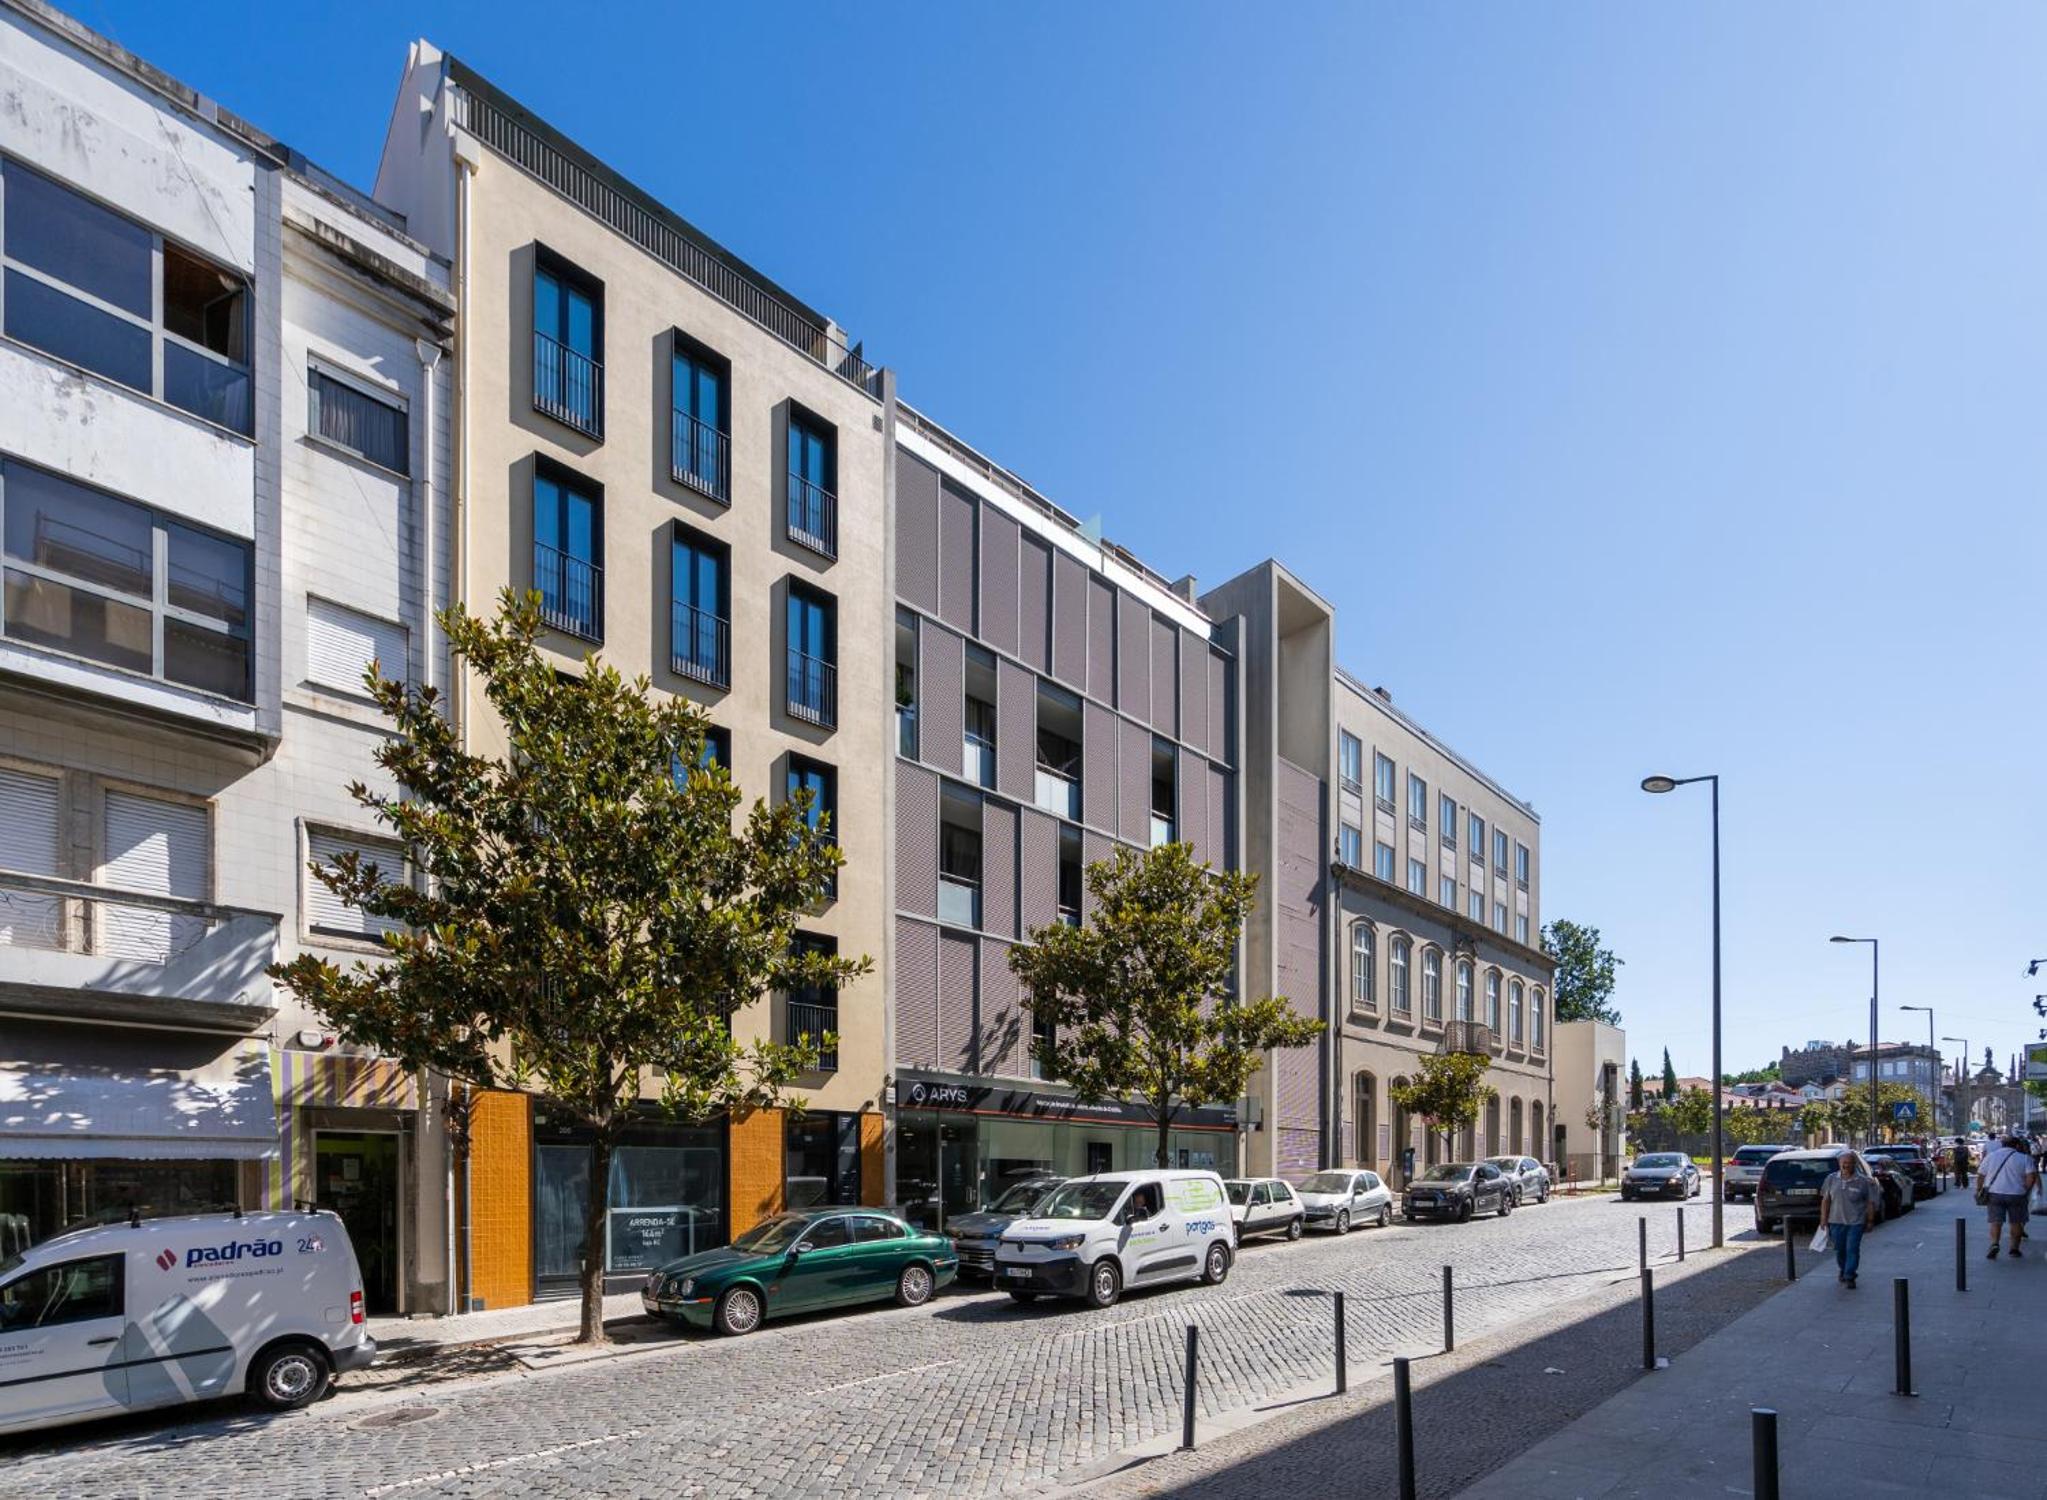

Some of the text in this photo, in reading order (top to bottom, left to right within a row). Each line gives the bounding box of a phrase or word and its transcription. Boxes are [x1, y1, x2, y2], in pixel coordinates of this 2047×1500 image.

[929, 1087, 968, 1102] ARYS
[1185, 1221, 1215, 1236] portgas
[186, 1238, 283, 1268] padrão
